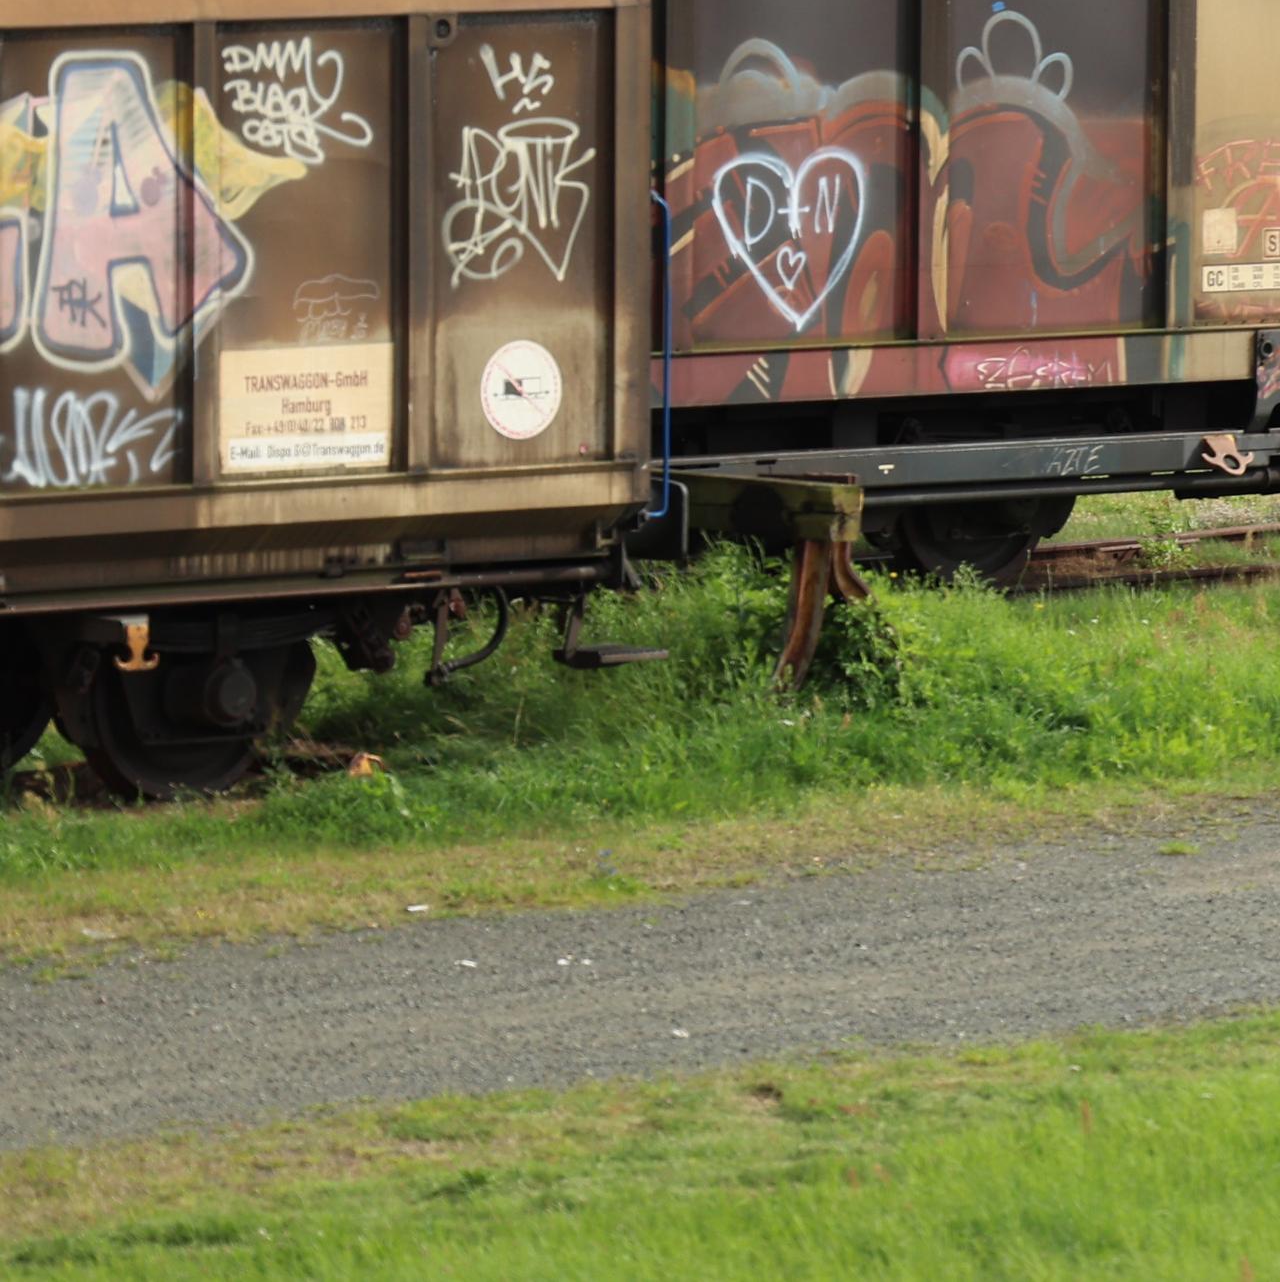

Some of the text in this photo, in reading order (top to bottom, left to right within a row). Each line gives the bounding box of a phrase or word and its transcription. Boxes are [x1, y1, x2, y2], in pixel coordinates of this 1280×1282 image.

[1206, 270, 1224, 287] GC
[244, 371, 368, 393] TRANSWAGGON-GmbH
[281, 398, 332, 416] Hamburg
